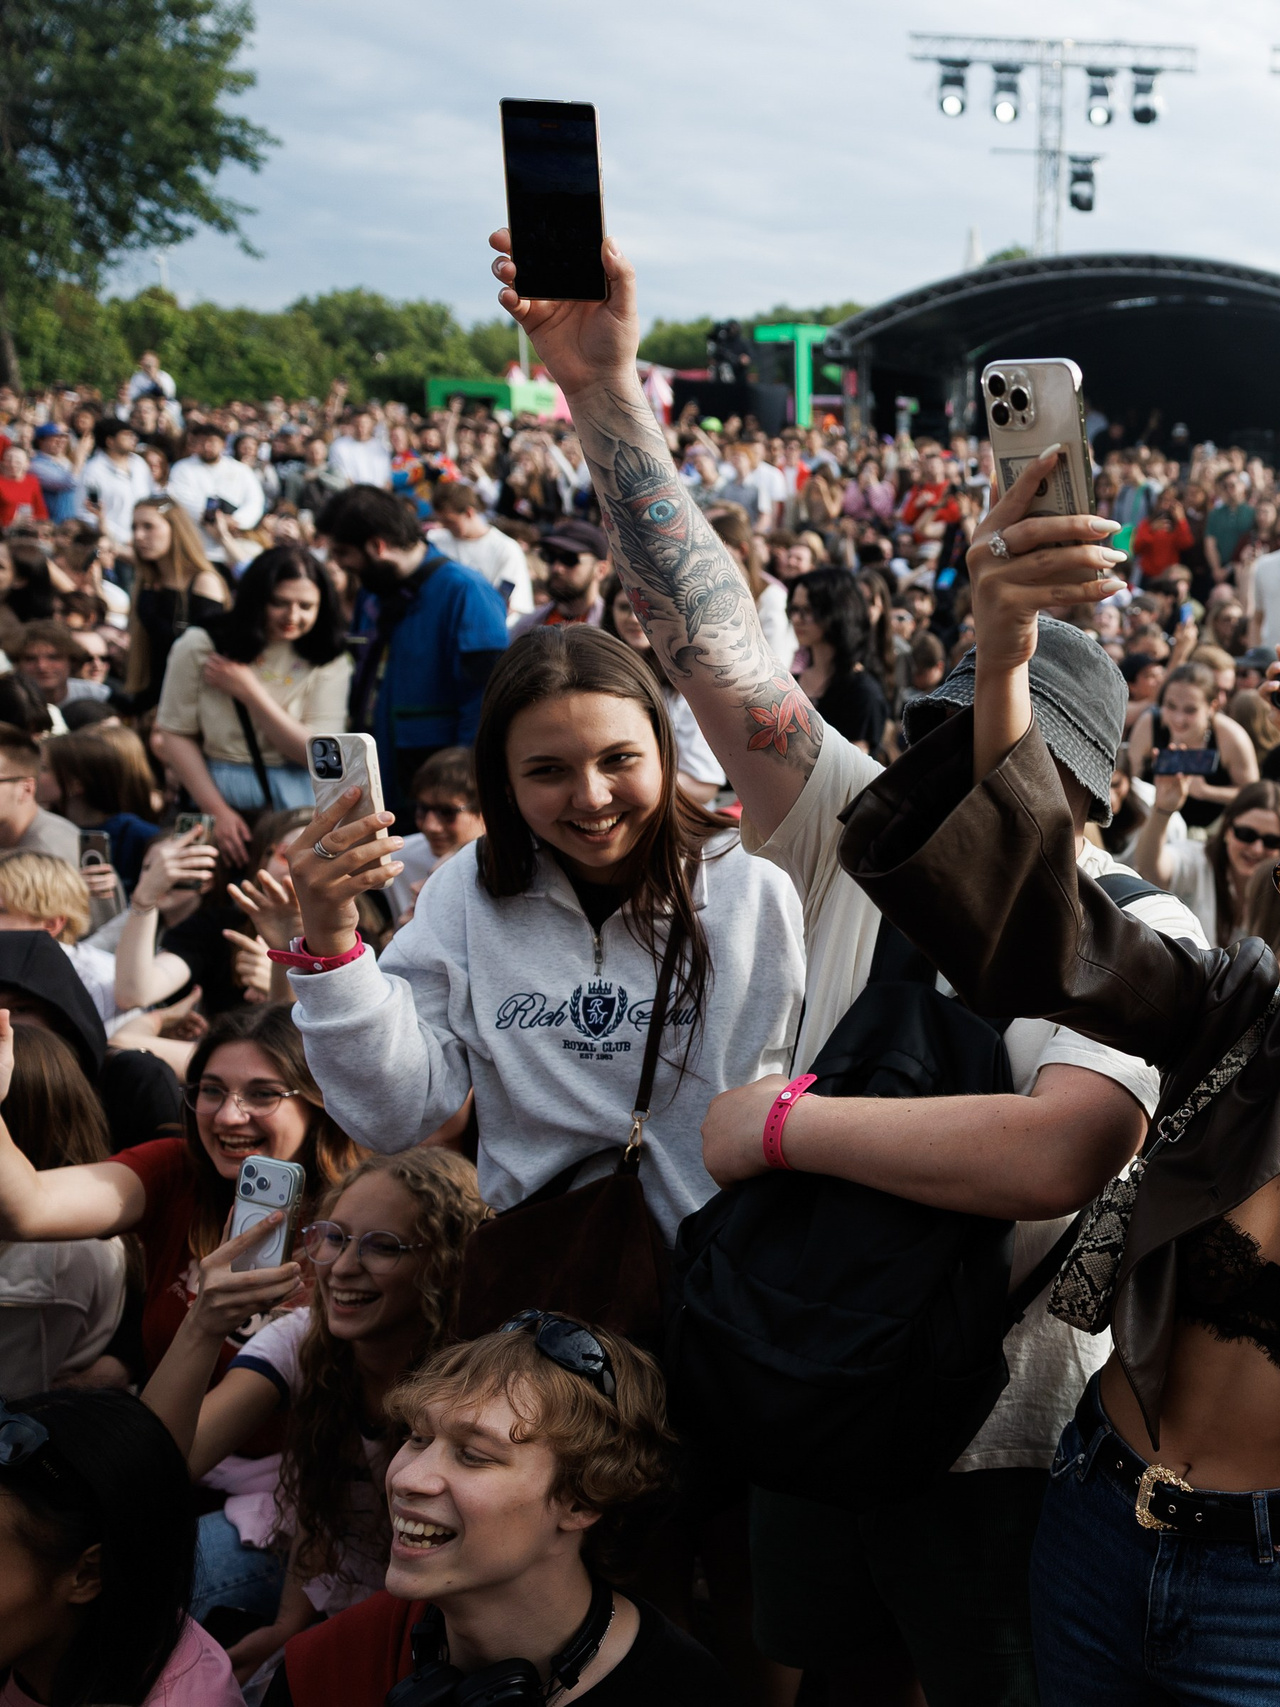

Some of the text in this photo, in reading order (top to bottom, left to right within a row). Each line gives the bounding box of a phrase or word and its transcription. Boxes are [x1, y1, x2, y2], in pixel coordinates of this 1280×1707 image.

[495, 992, 569, 1030] Rich
[562, 1039, 631, 1052] ROYAL CLUB
